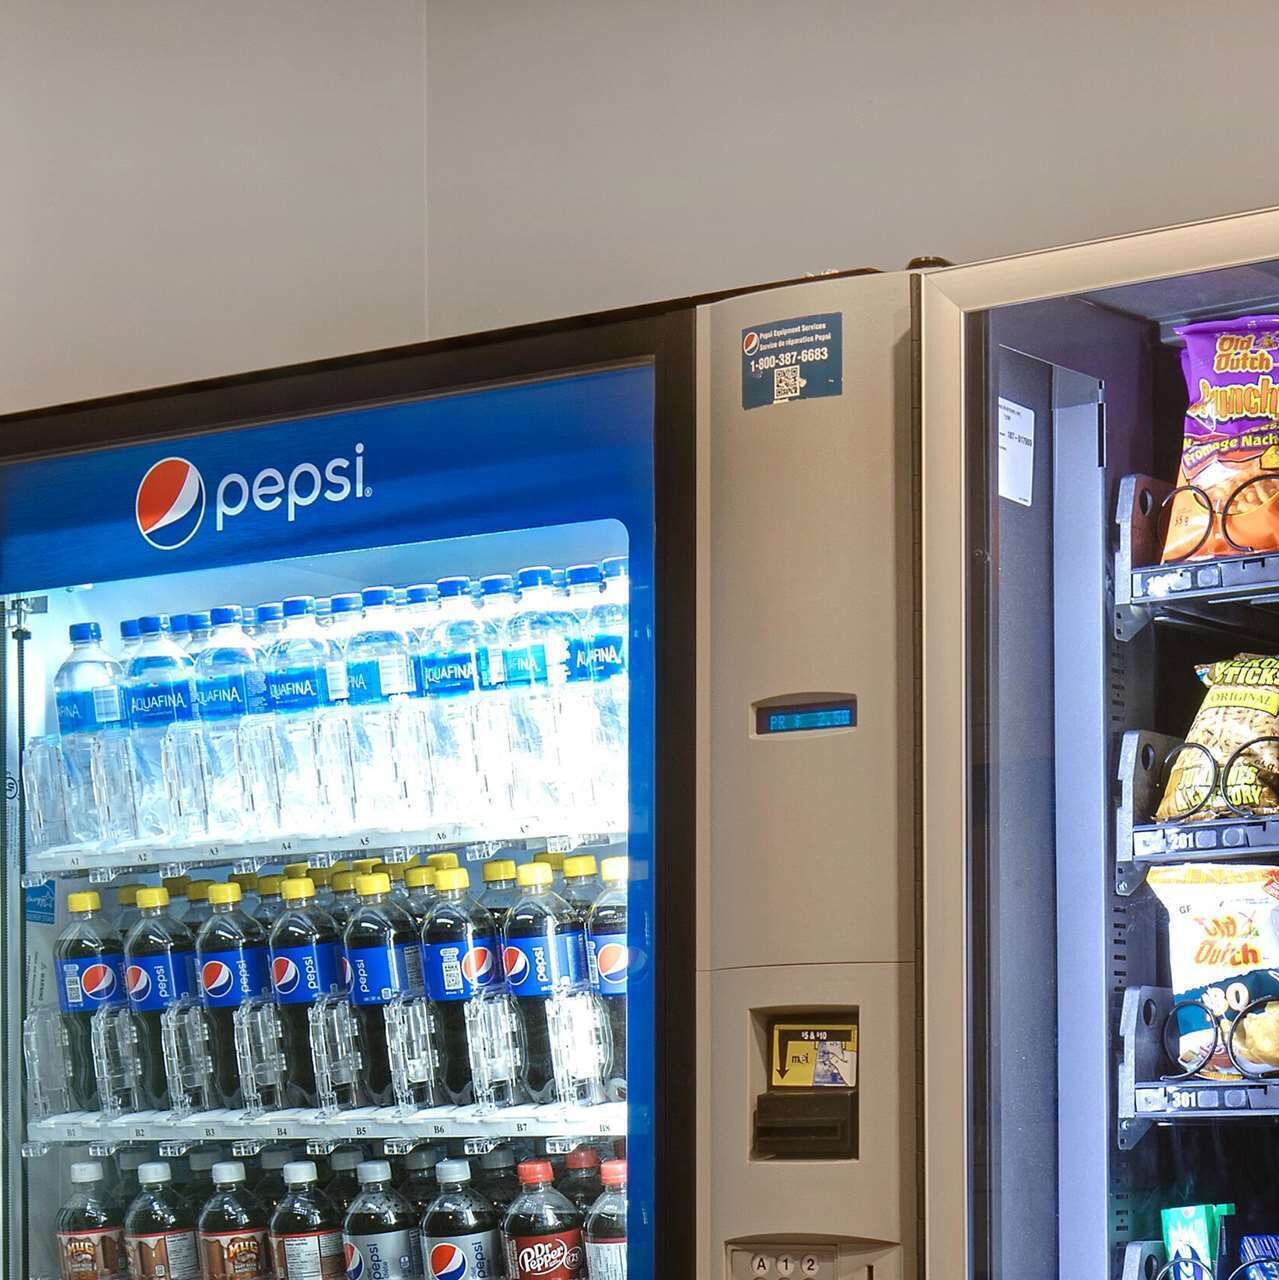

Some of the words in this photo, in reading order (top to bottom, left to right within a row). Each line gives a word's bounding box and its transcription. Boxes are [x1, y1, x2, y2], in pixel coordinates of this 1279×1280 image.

[1216, 334, 1255, 352] Old
[750, 347, 828, 372] 1-800-387-6683
[1214, 352, 1273, 374] Dutch
[215, 443, 366, 531] pepsi
[131, 692, 187, 713] AQUAFINA
[1210, 692, 1272, 706] ORIGINAL
[158, 965, 170, 998] pepsi
[240, 960, 253, 993] pepsi
[307, 956, 319, 989] pepsi
[1172, 1088, 1196, 1107] 301
[475, 1241, 489, 1279] pepsi
[519, 1246, 564, 1272] Pepper
[533, 1243, 552, 1258] Dr
[757, 1258, 766, 1270] A
[783, 1258, 789, 1270] 1
[807, 1258, 814, 1271] 2
